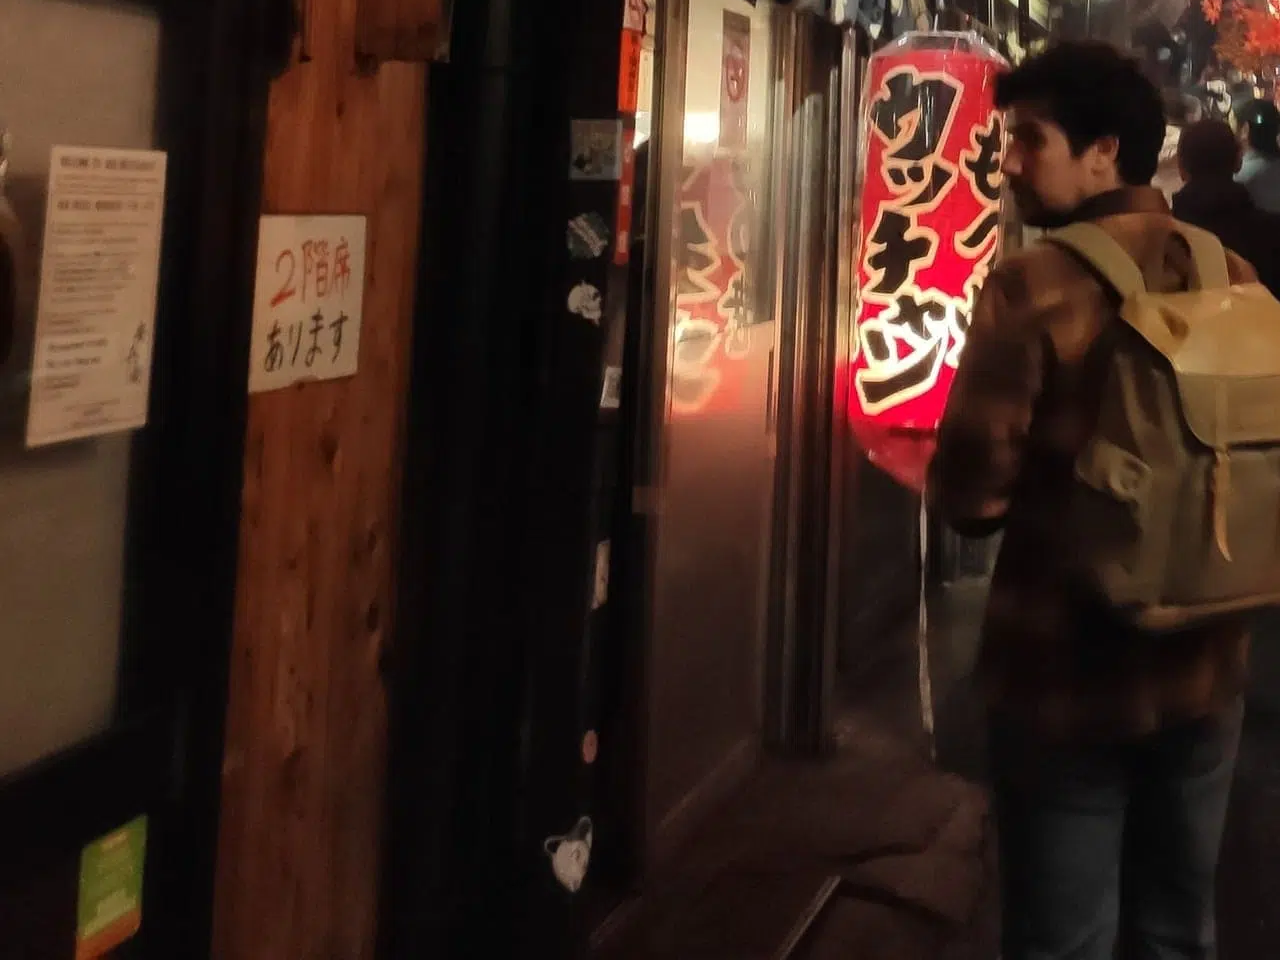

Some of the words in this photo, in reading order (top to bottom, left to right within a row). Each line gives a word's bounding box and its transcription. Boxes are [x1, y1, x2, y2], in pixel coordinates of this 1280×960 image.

[270, 236, 352, 308] 2階席
[264, 307, 350, 373] あります
